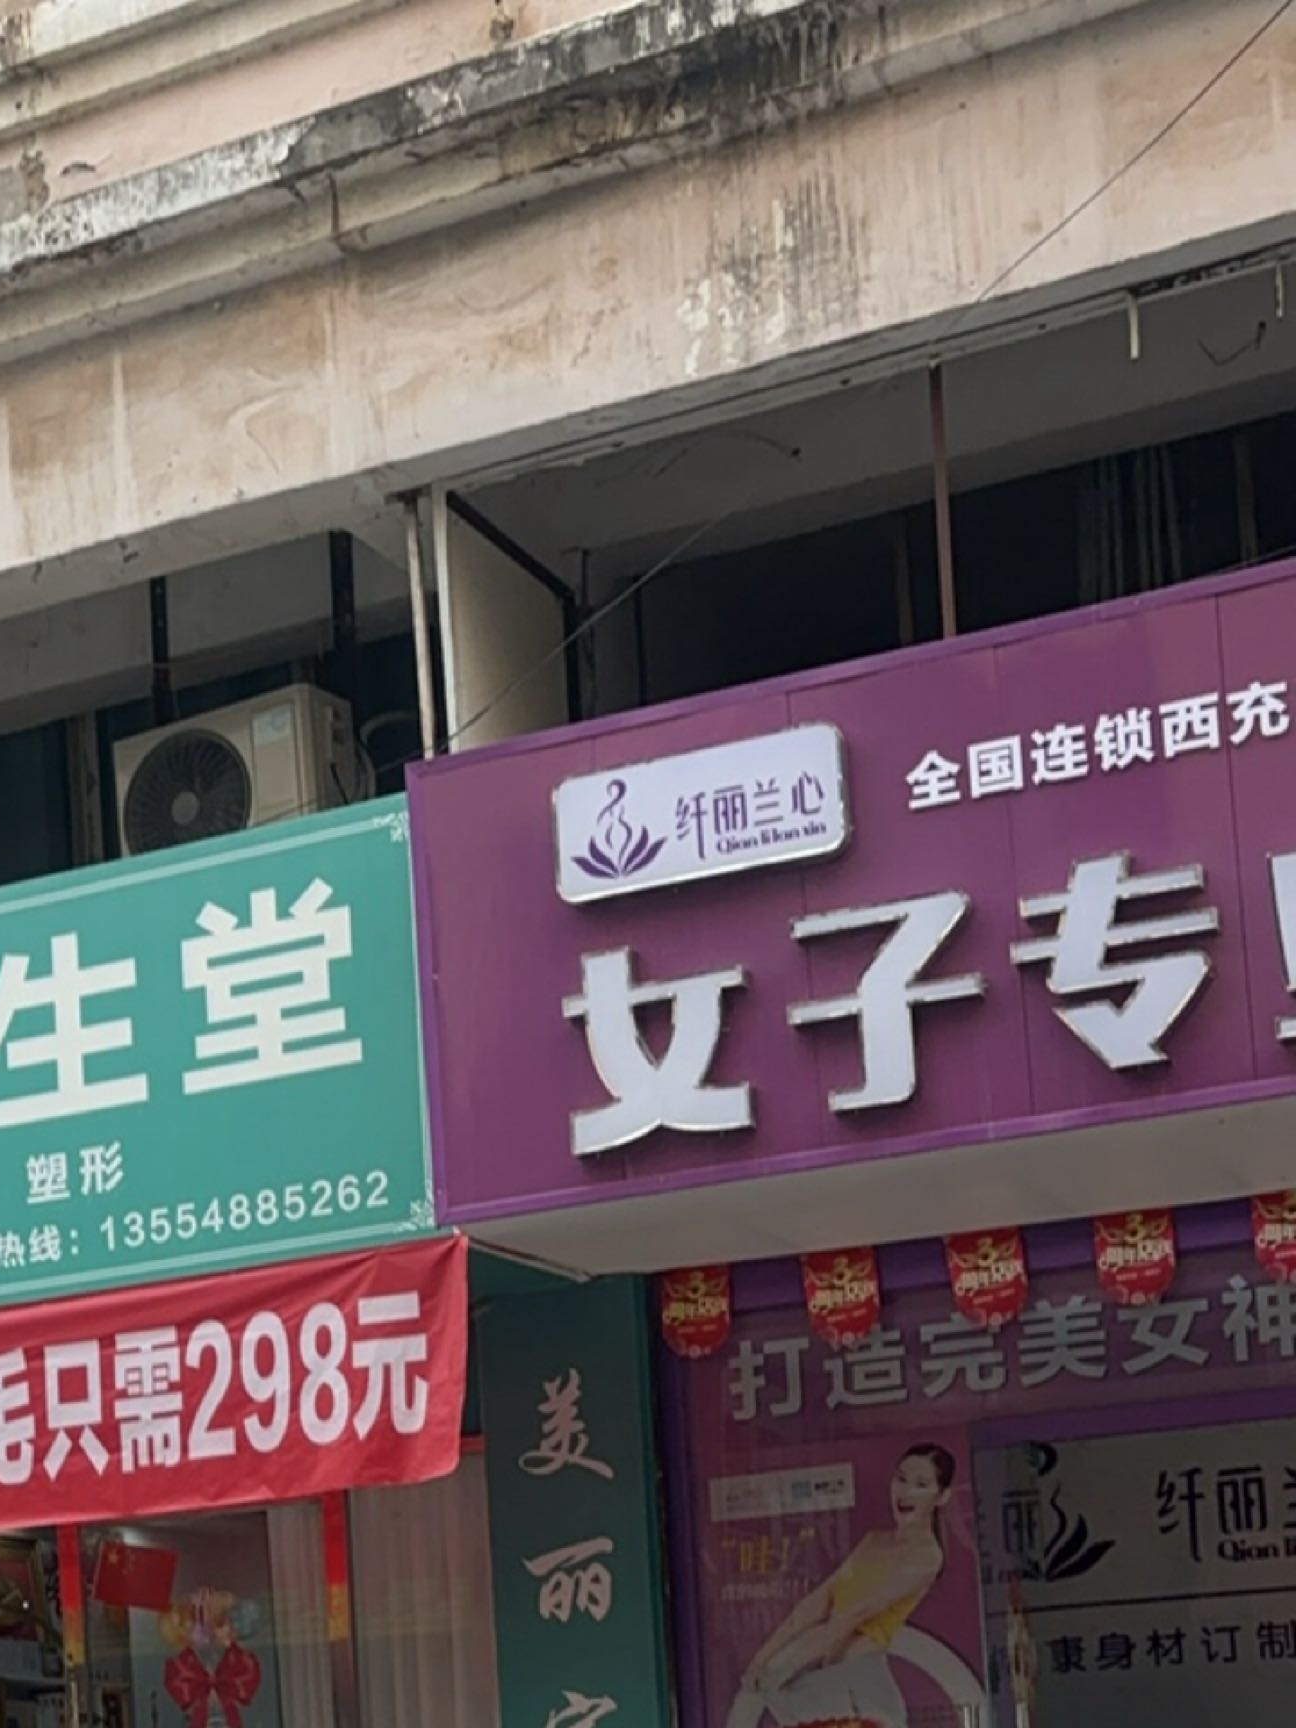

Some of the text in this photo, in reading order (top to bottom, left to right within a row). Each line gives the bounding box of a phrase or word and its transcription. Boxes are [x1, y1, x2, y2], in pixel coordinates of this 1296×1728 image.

[906, 681, 1291, 811] 全国连锁西充
[675, 770, 825, 861] 纤丽兰心
[562, 848, 1296, 1158] 女子专
[25, 1141, 125, 1205] 塑形
[728, 1272, 1296, 1422] 打造完美女神
[1155, 1466, 1296, 1563] 纤丽
